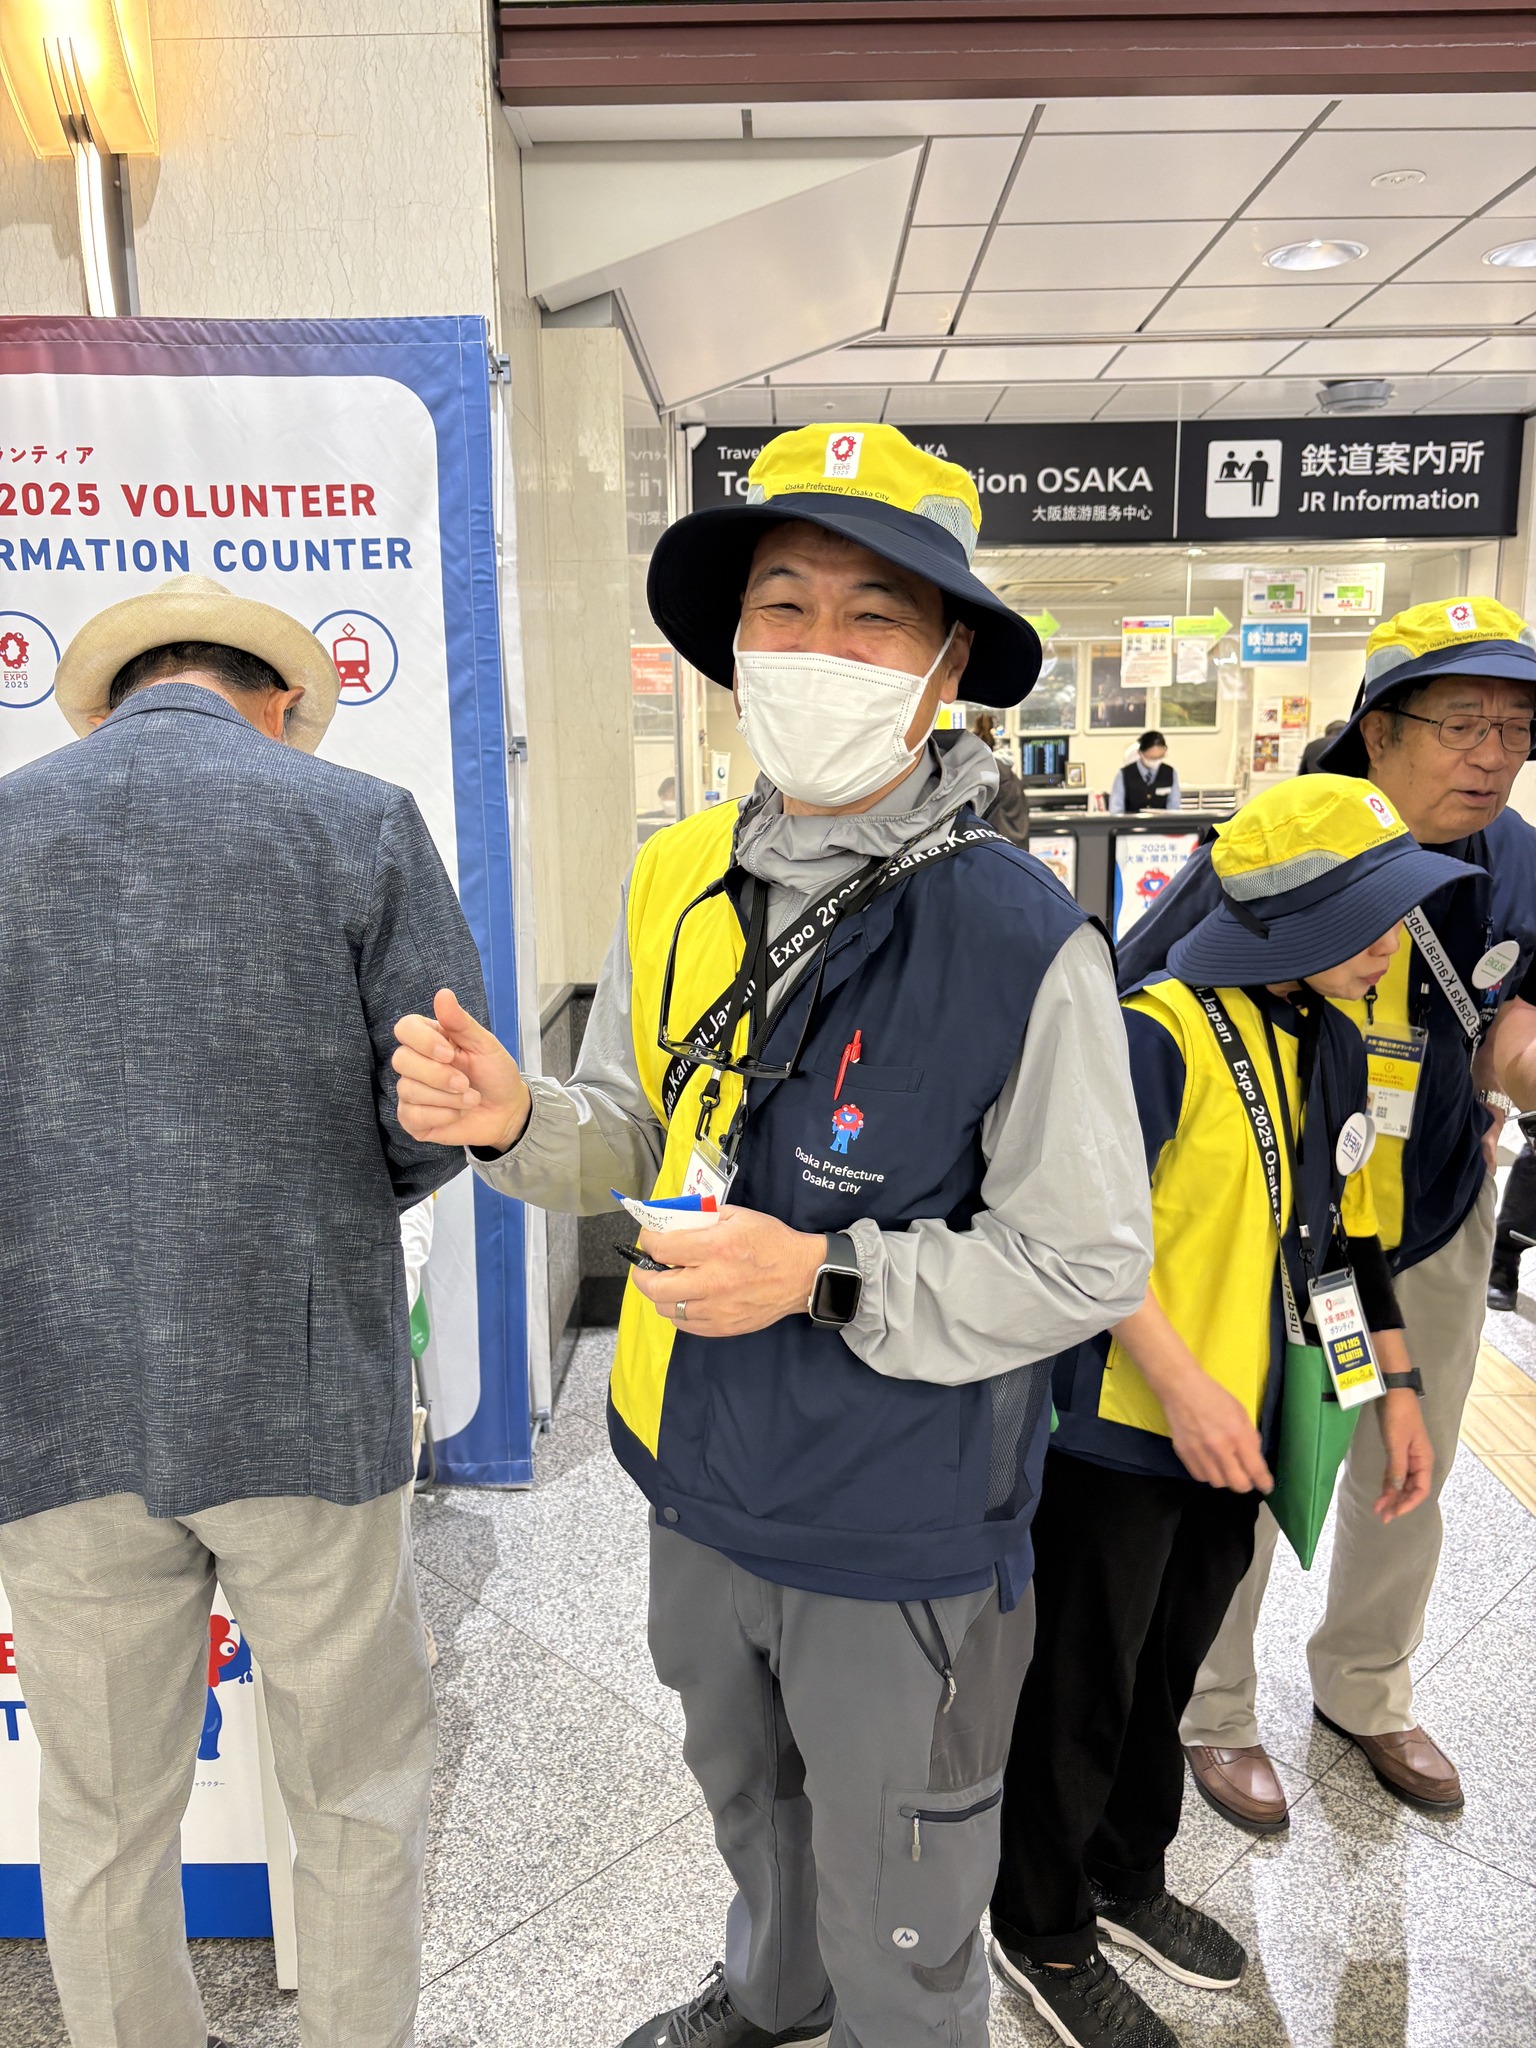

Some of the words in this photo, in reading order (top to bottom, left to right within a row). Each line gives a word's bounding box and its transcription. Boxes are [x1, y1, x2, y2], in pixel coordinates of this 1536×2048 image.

[0, 445, 94, 465] ンティア
[1300, 440, 1485, 477] 鉄道案内所
[784, 482, 804, 491] Osaka
[806, 482, 843, 493] Prefecture
[850, 487, 873, 498] Osaka
[875, 491, 890, 502] City
[1036, 466, 1154, 494] OSAKA
[0, 482, 100, 517] 2025
[120, 484, 377, 518] VOLUNTEER
[1298, 491, 1326, 513] JR
[1332, 487, 1480, 512] Information
[1031, 504, 1153, 523] 大阪旅游服务中心
[212, 537, 413, 572] COUNTER
[1247, 631, 1303, 647] 鉄道案内
[1429, 640, 1446, 649] Osaka
[3, 673, 28, 681] EXPO
[4, 681, 29, 689] 2025
[768, 924, 815, 969] Expo
[1232, 1059, 1256, 1102] Expo
[1250, 1105, 1275, 1149] 2025
[795, 1146, 820, 1169] Osaka
[822, 1160, 885, 1183] Prefecture
[802, 1169, 836, 1190] Osaka
[838, 1181, 862, 1195] City
